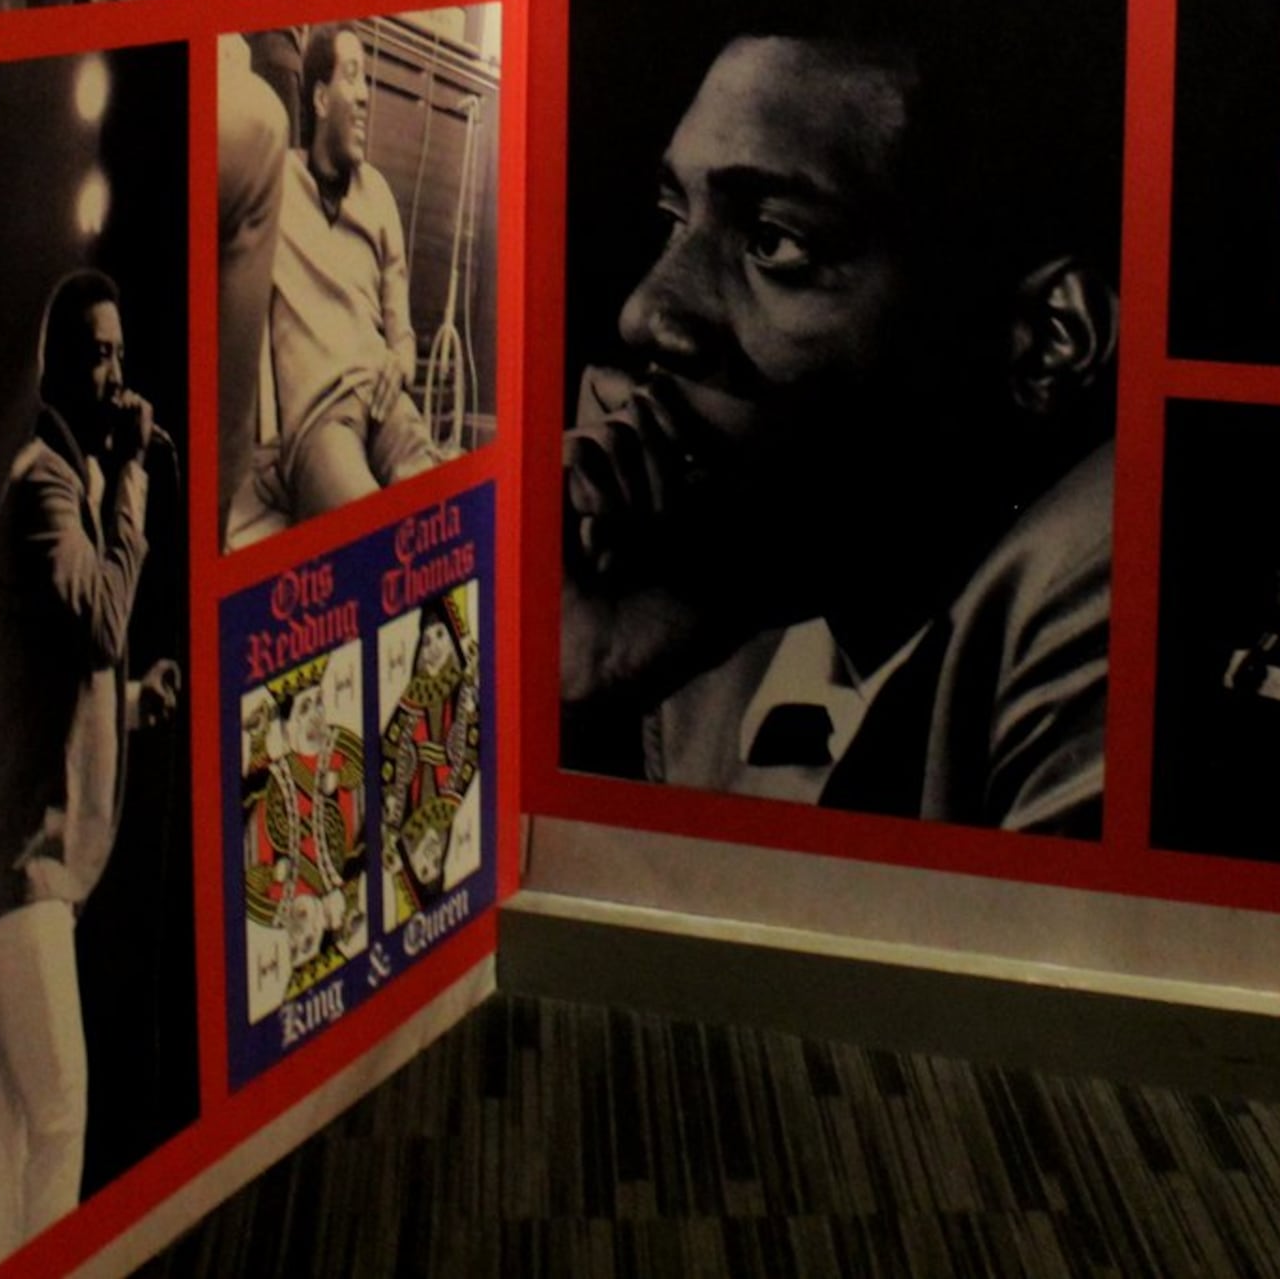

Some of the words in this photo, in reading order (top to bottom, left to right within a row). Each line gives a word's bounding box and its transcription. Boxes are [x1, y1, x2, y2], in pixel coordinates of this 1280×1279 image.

[271, 562, 333, 621] Otis
[382, 541, 475, 616] Thomas
[248, 598, 360, 680] Redding
[280, 978, 345, 1048] King
[403, 889, 469, 956] Queen
